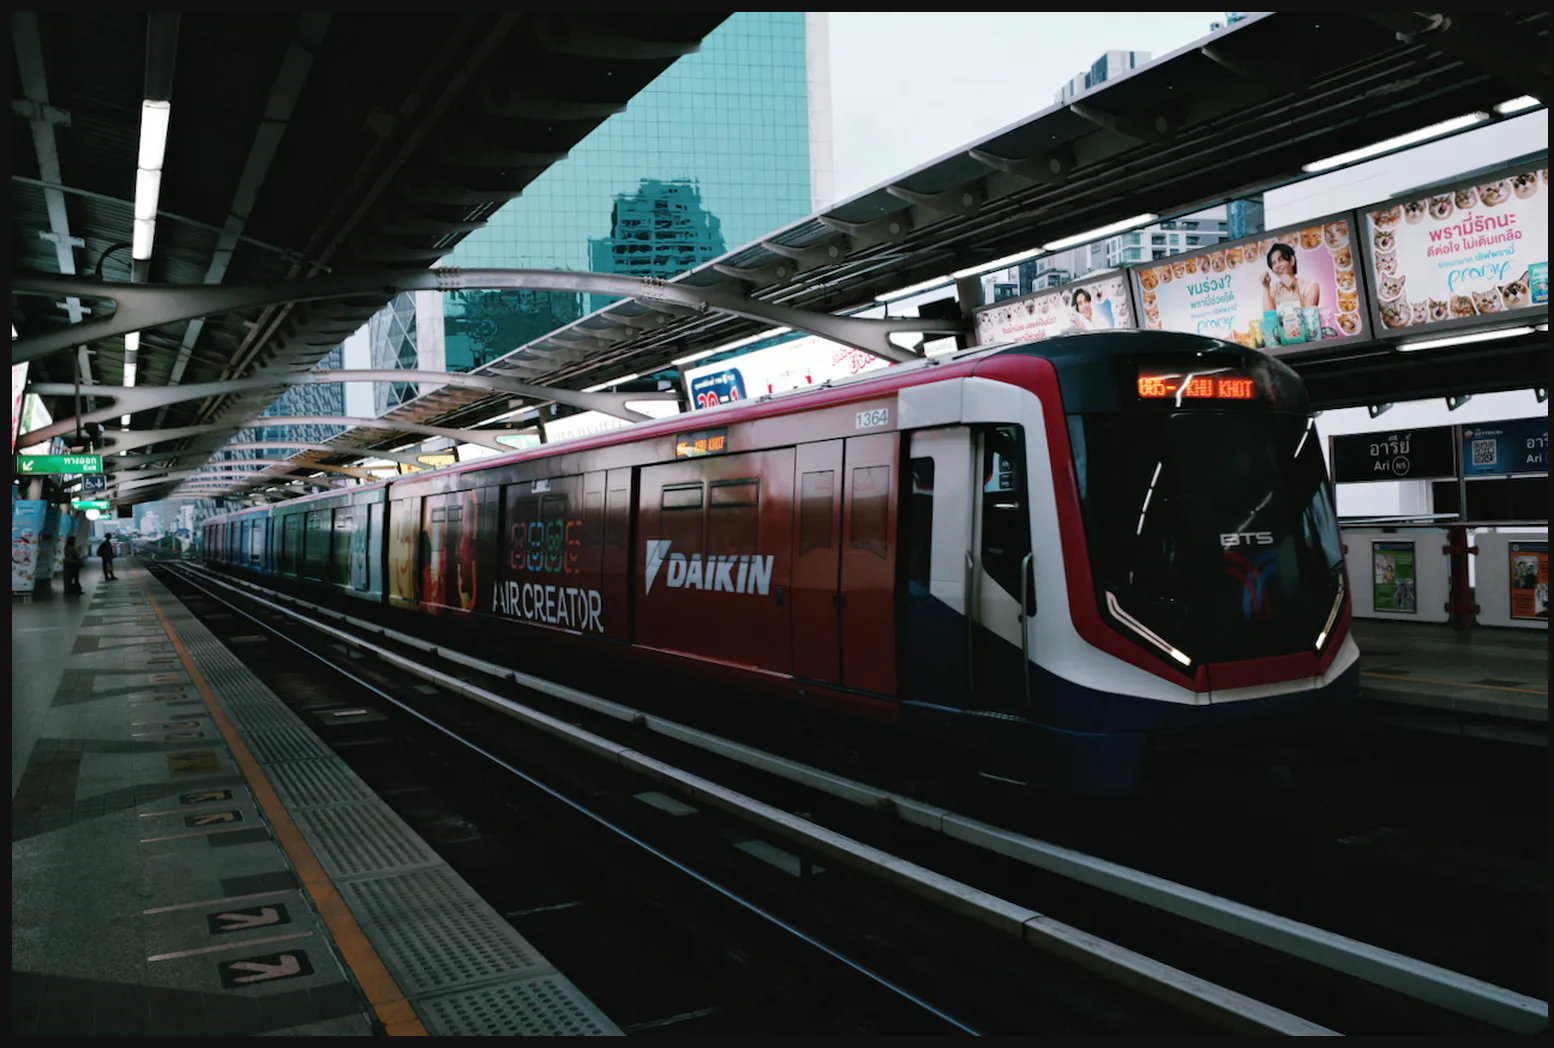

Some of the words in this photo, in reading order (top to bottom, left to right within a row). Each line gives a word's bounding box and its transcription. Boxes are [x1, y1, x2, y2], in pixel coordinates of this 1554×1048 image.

[1429, 211, 1517, 242] พรามี่รักนะ
[1427, 240, 1460, 257] ดีต่อใจ
[1187, 274, 1232, 296] ขนร่วง?
[1186, 379, 1212, 396] KHU
[856, 410, 888, 427] 1364
[1369, 433, 1411, 456] อารีย์
[63, 457, 97, 465] ทางออก
[1374, 460, 1390, 471] Ari
[1526, 453, 1543, 463] Ari
[1220, 531, 1274, 547] BTS
[666, 552, 775, 596] DAIKIN
[492, 580, 521, 617] AIR
[522, 582, 604, 633] CREATOR
